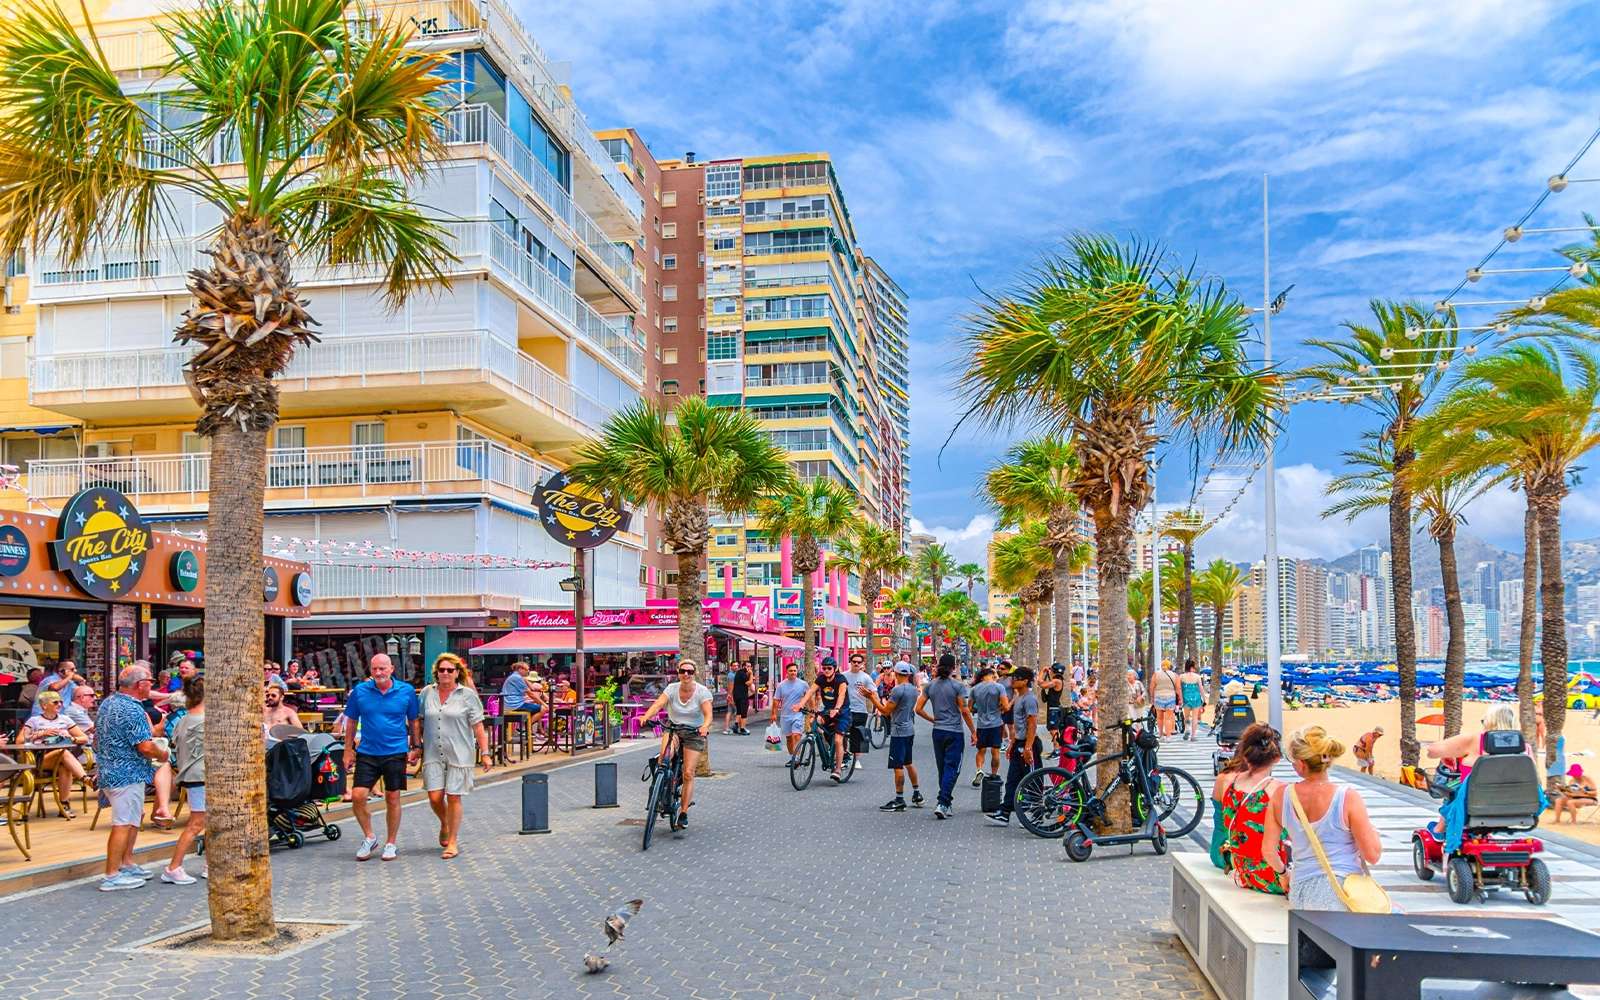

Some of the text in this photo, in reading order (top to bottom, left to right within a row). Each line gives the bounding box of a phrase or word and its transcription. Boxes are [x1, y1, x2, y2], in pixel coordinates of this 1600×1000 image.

[542, 490, 622, 528] The City
[66, 528, 148, 562] The City
[528, 613, 569, 626] Helados
